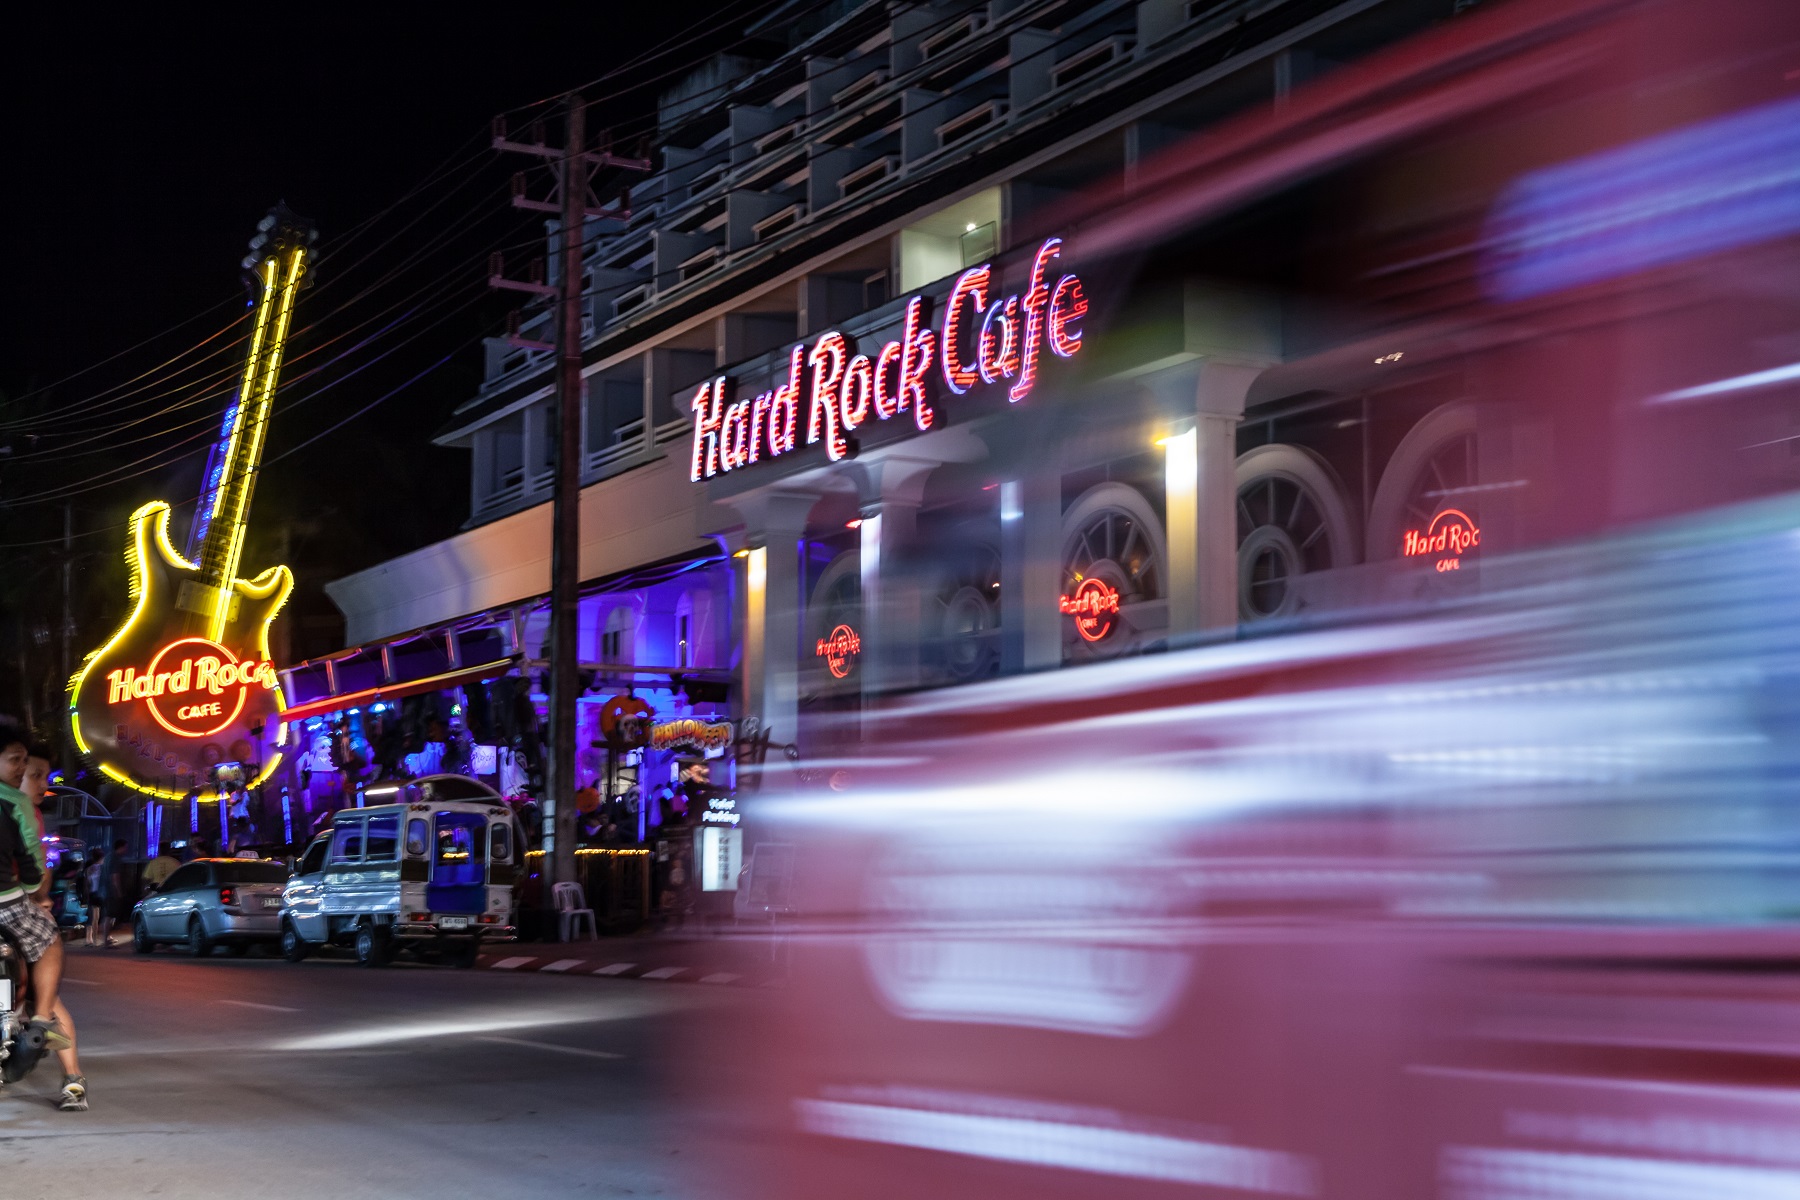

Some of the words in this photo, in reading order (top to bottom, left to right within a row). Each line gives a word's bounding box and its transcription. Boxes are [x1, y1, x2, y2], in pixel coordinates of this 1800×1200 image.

[691, 344, 804, 483] Hard
[807, 295, 936, 462] Rock
[941, 236, 1089, 404] Cafe
[1404, 525, 1448, 556] Hard
[1450, 524, 1481, 554] Roc
[1436, 558, 1460, 573] CAFE
[1059, 591, 1090, 614] Hard
[1090, 587, 1119, 616] Rock
[107, 658, 193, 705] Hard
[194, 655, 278, 695] Rock
[177, 701, 223, 720] CAFE
